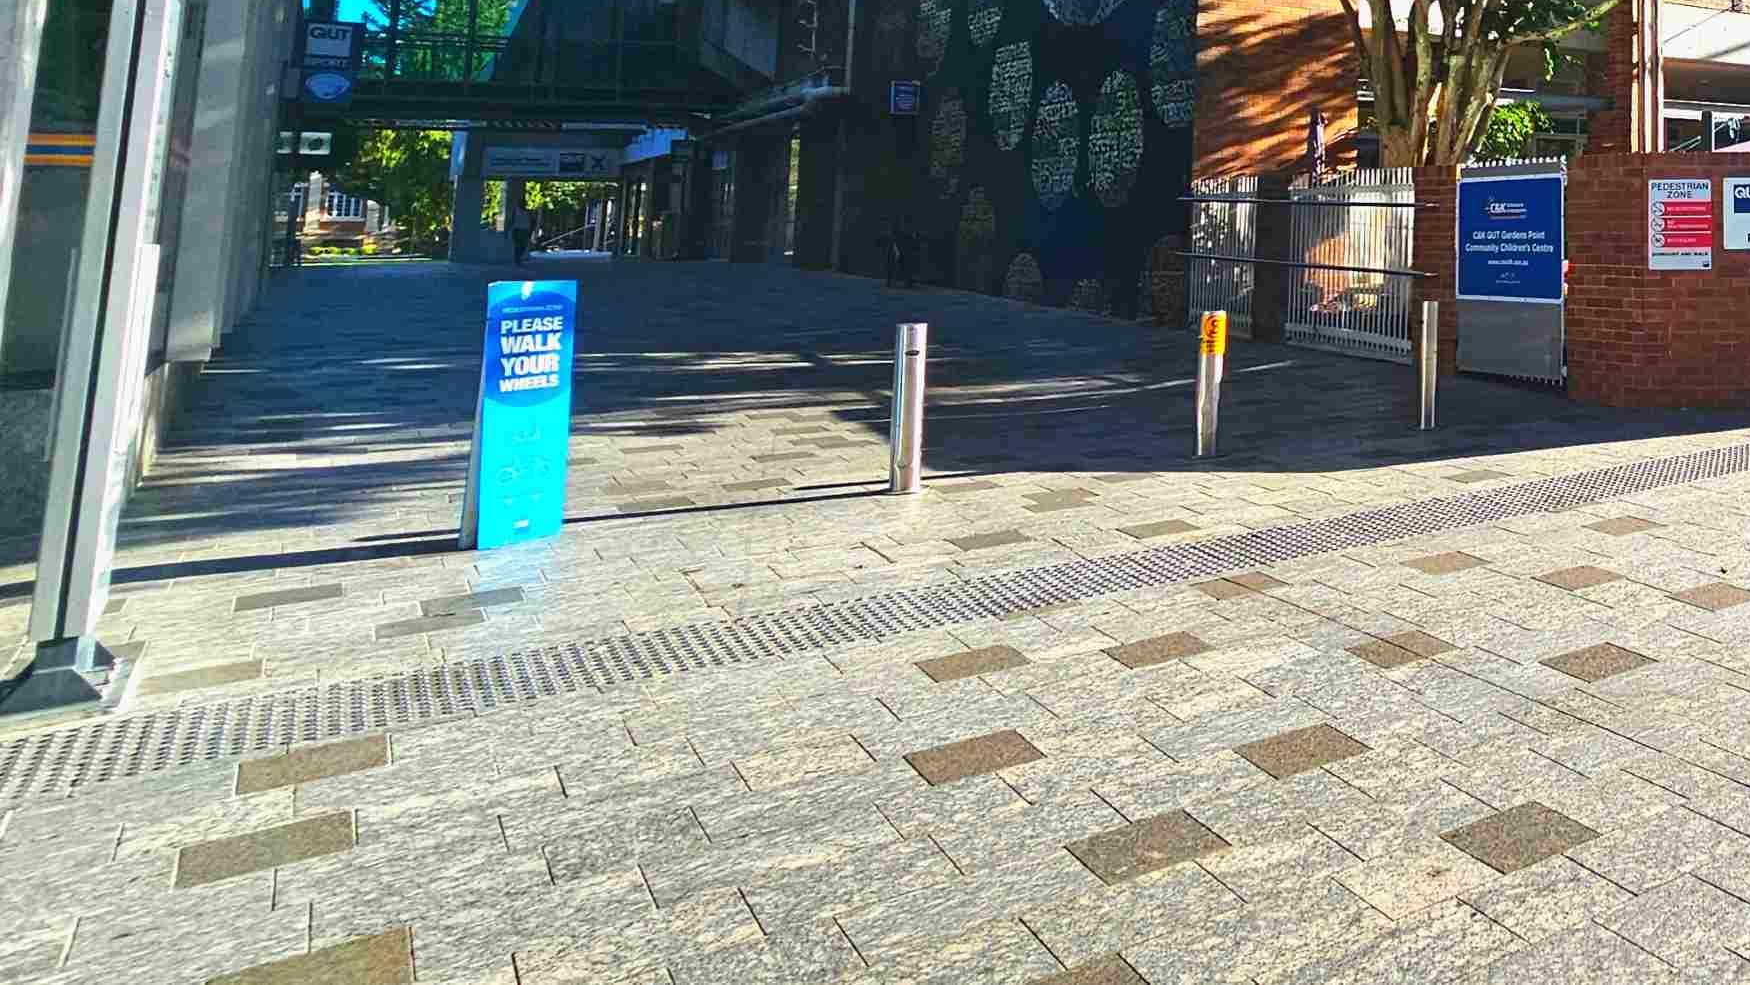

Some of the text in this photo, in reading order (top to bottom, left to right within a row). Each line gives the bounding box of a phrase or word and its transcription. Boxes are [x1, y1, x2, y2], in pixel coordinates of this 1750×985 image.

[309, 25, 352, 40] QUT
[1651, 182, 1709, 191] PEDESTRIAN
[1667, 191, 1693, 199] ZONE
[1487, 230, 1500, 240] QUT
[1501, 230, 1528, 240] Gardens
[1528, 230, 1545, 240] Point
[1464, 243, 1499, 254] Community
[500, 316, 563, 334] PLEASE
[501, 332, 563, 355] WALK
[501, 353, 560, 377] YOUR
[499, 374, 560, 393] WHEELS
